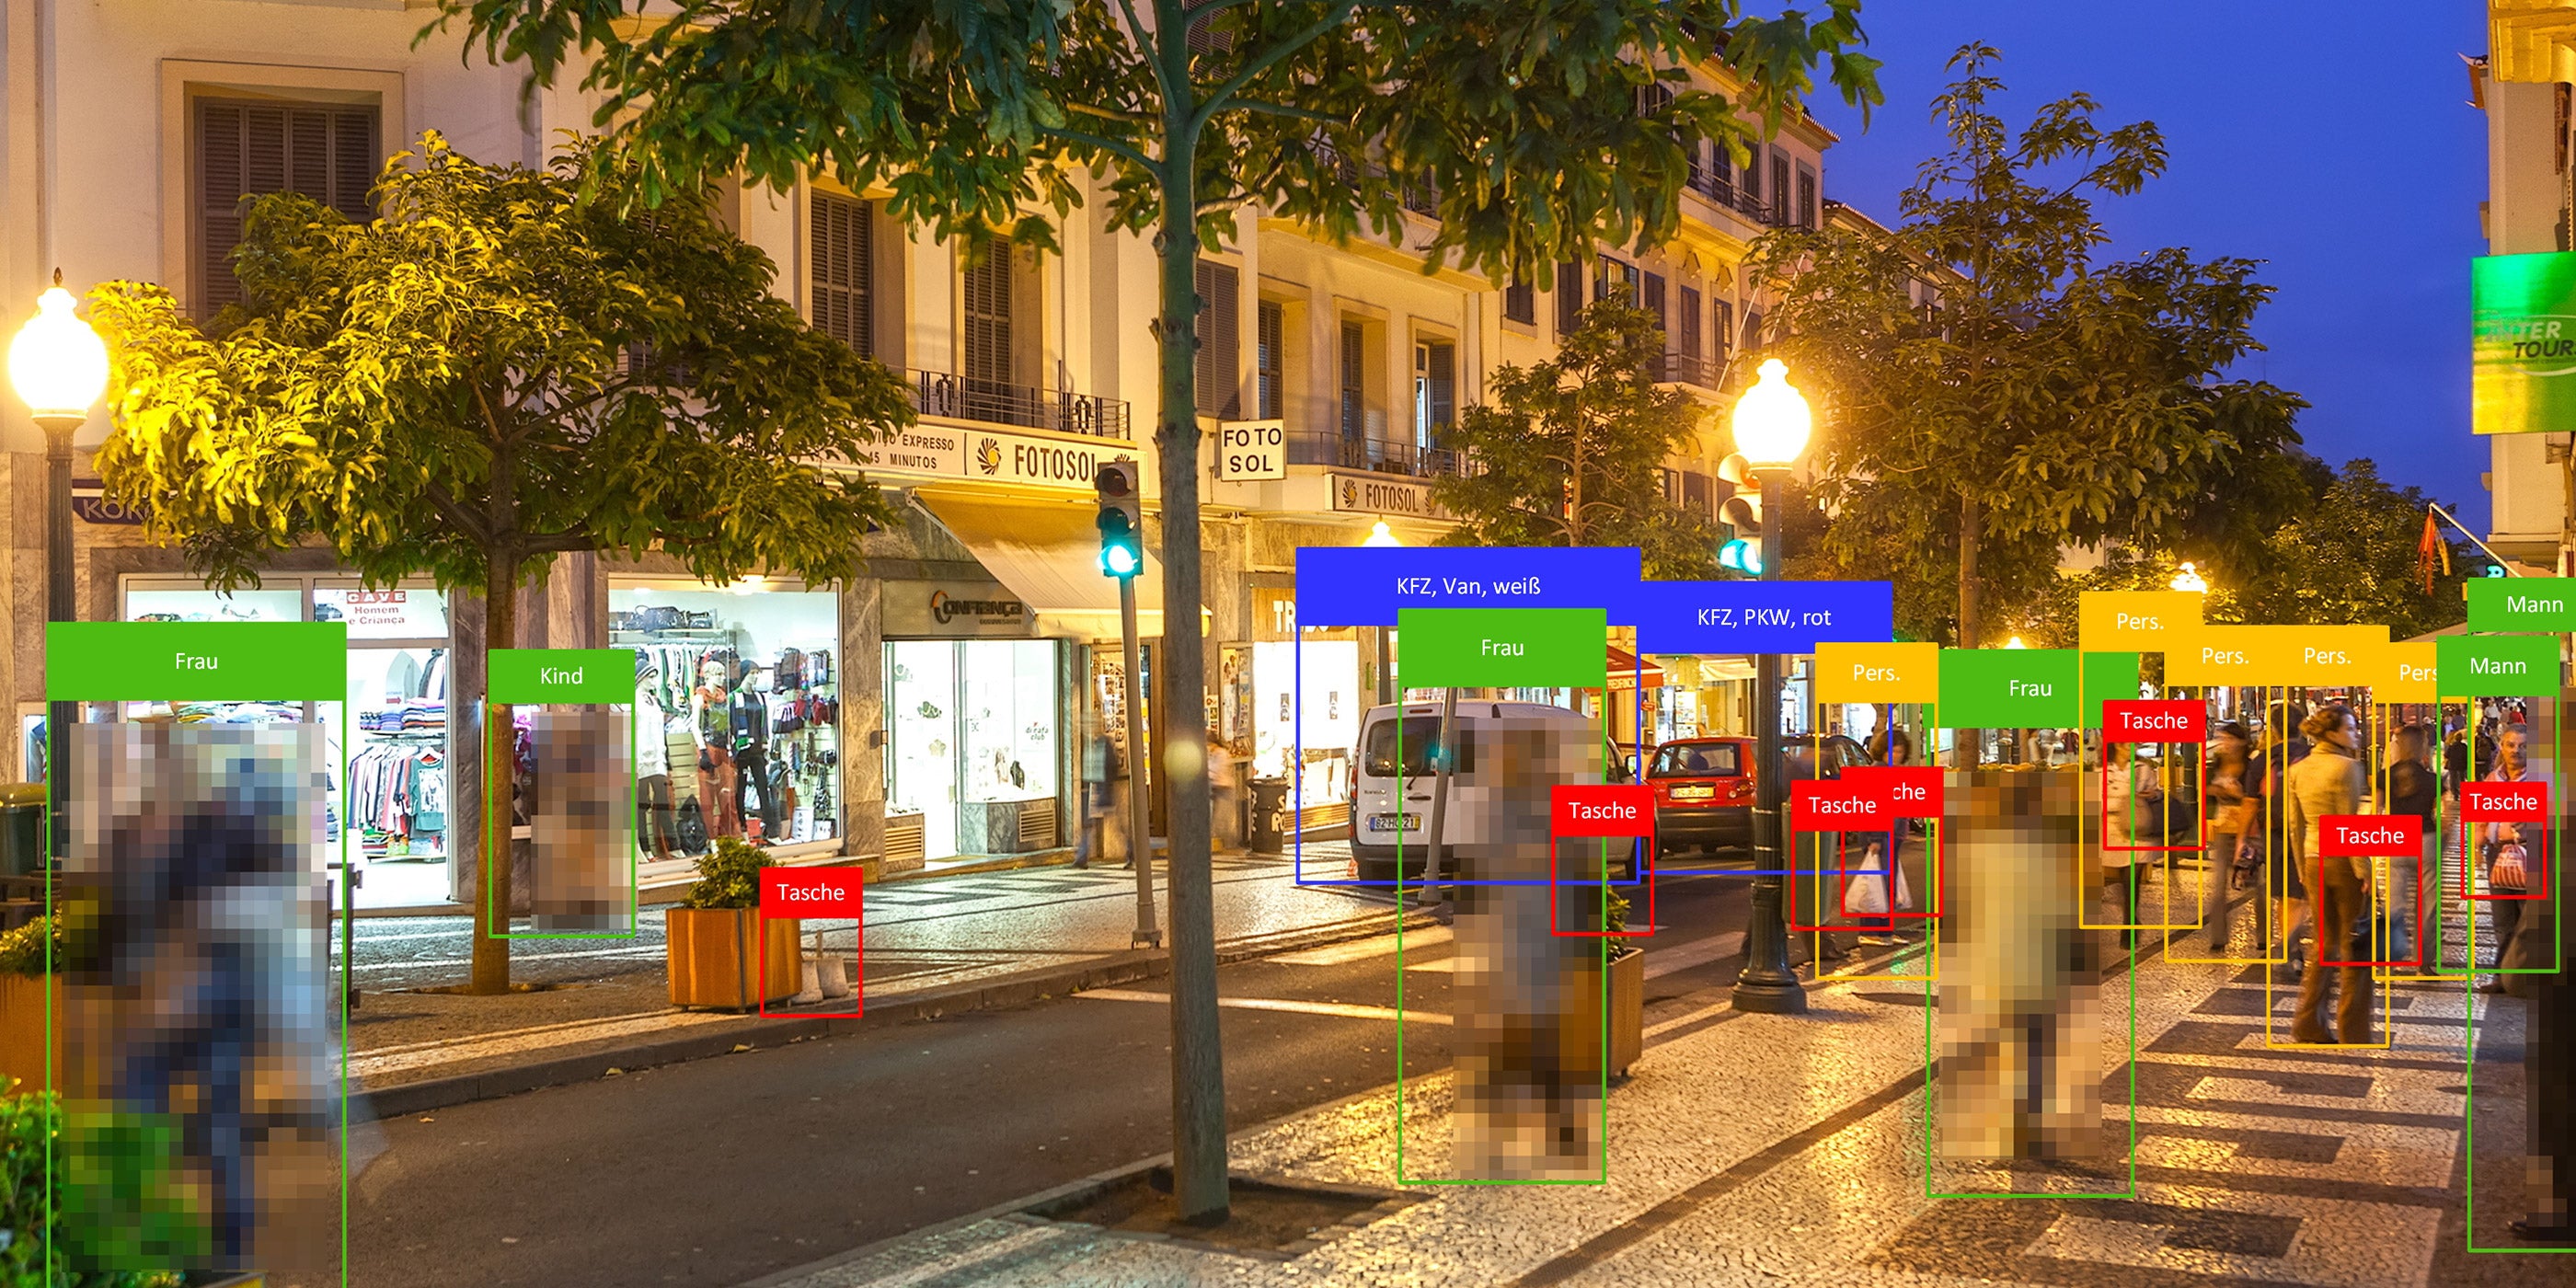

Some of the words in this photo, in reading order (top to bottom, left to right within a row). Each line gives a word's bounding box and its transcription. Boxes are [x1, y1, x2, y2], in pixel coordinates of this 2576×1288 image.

[2513, 339, 2576, 359] TOUR
[903, 434, 954, 451] EXPRESSO
[890, 454, 937, 469] MINUTOS
[1229, 454, 1273, 473] SOL
[1366, 484, 1419, 512] FOTOSOL
[348, 592, 405, 603] CAVE
[354, 606, 399, 615] Homem
[360, 615, 405, 625] Criança
